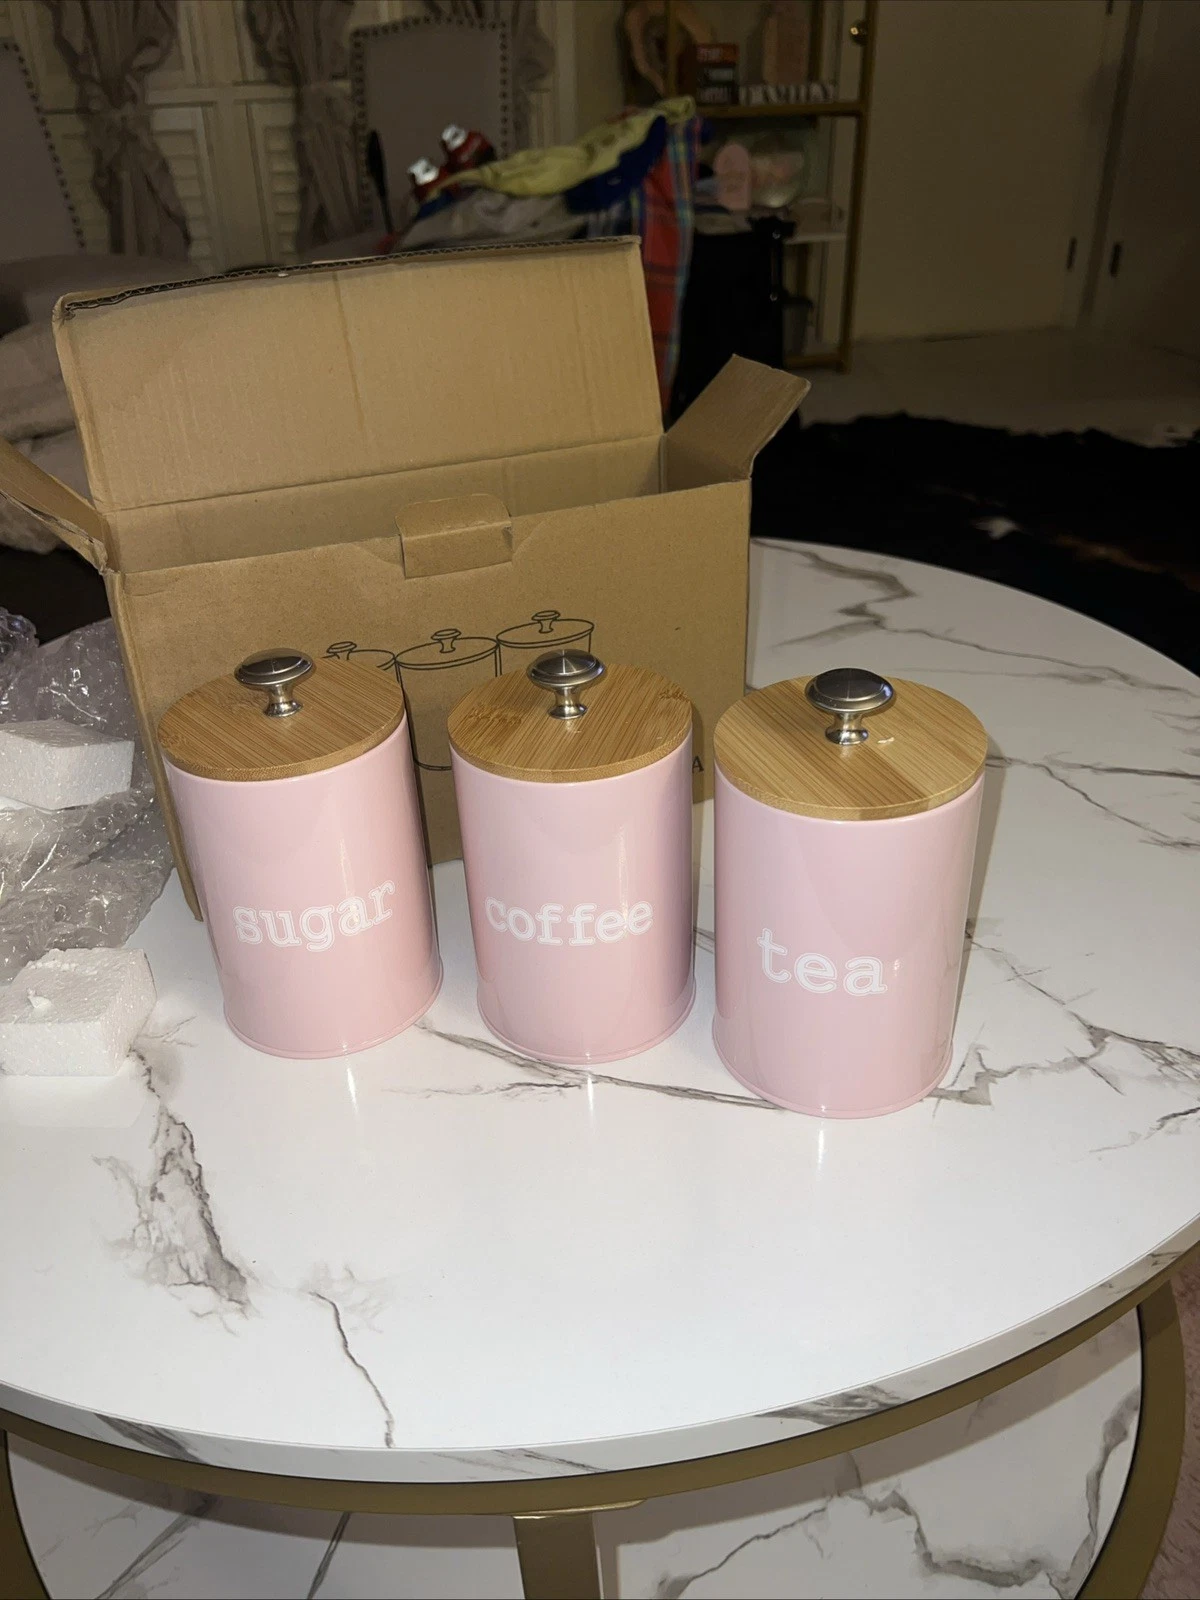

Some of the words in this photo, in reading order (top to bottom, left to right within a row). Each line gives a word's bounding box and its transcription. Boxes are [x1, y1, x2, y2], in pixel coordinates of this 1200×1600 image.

[233, 880, 395, 952] sugar
[485, 897, 654, 946] coffee
[757, 928, 888, 996] tea
